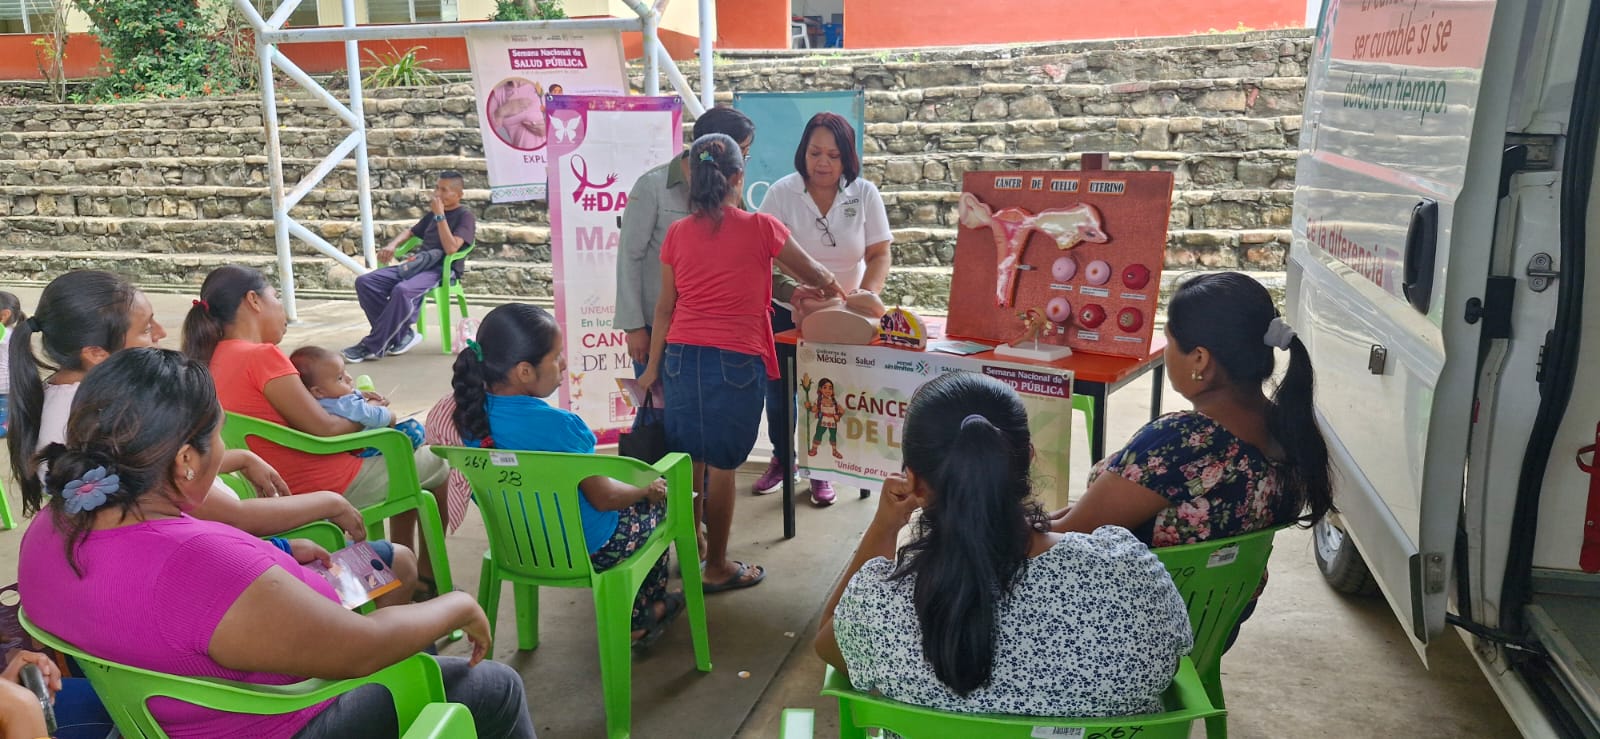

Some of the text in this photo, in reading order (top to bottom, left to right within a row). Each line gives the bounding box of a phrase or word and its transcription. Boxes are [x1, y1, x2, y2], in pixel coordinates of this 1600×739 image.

[1353, 10, 1452, 59] ser curable si se
[512, 49, 539, 57] Semana
[541, 48, 571, 56] Nacional
[514, 57, 584, 68] SALUD PÚBLICA
[1343, 73, 1381, 111] detecta
[1031, 179, 1042, 189] DE
[1051, 181, 1078, 191] CUELLO
[1090, 182, 1124, 193] UTERINO
[1328, 224, 1384, 288] diferencia
[581, 318, 593, 328] En
[582, 332, 629, 349] CAN
[583, 354, 608, 372] DE
[817, 354, 847, 365] México
[855, 356, 876, 367] Salud
[986, 367, 1016, 378] Semana
[1018, 371, 1050, 382] Nacional
[1053, 376, 1062, 384] de
[1021, 381, 1065, 396] PÚBLICA
[846, 416, 879, 444] DE
[864, 467, 879, 476] por
